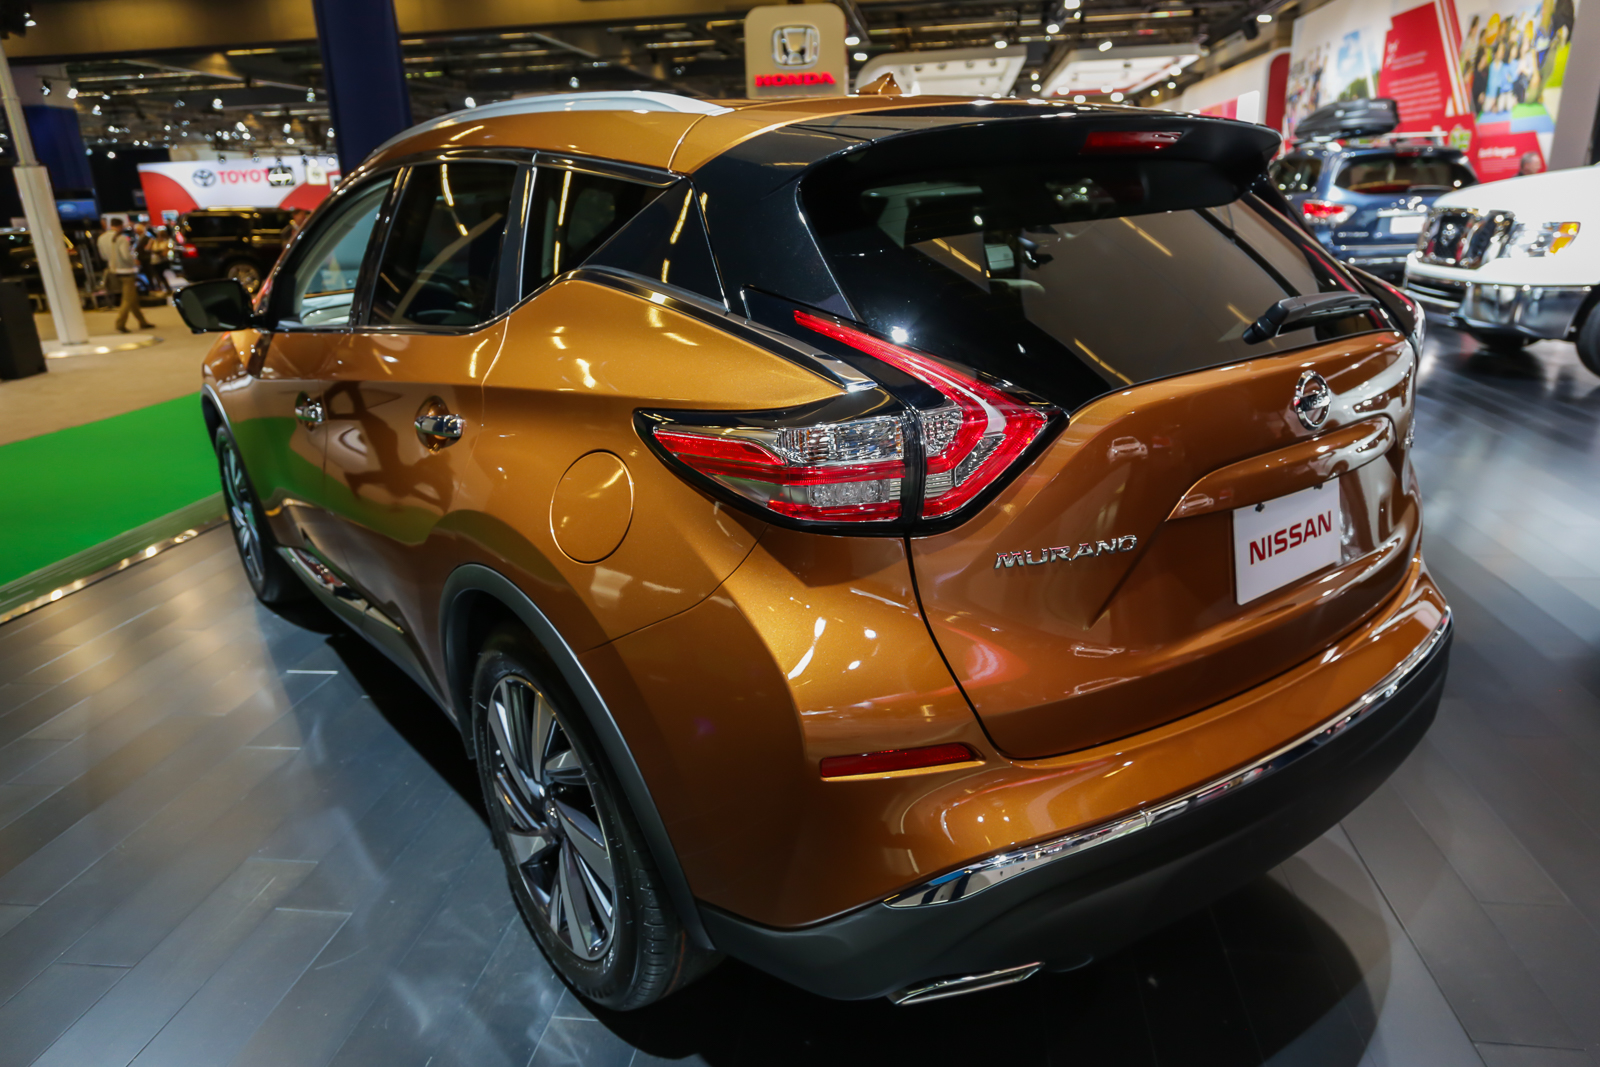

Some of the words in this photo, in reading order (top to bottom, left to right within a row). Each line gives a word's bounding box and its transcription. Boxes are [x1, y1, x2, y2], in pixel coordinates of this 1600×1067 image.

[755, 72, 836, 87] HONDA
[217, 168, 270, 184] TOYOT
[1249, 510, 1332, 565] NISSAN
[994, 534, 1138, 569] MURANO
